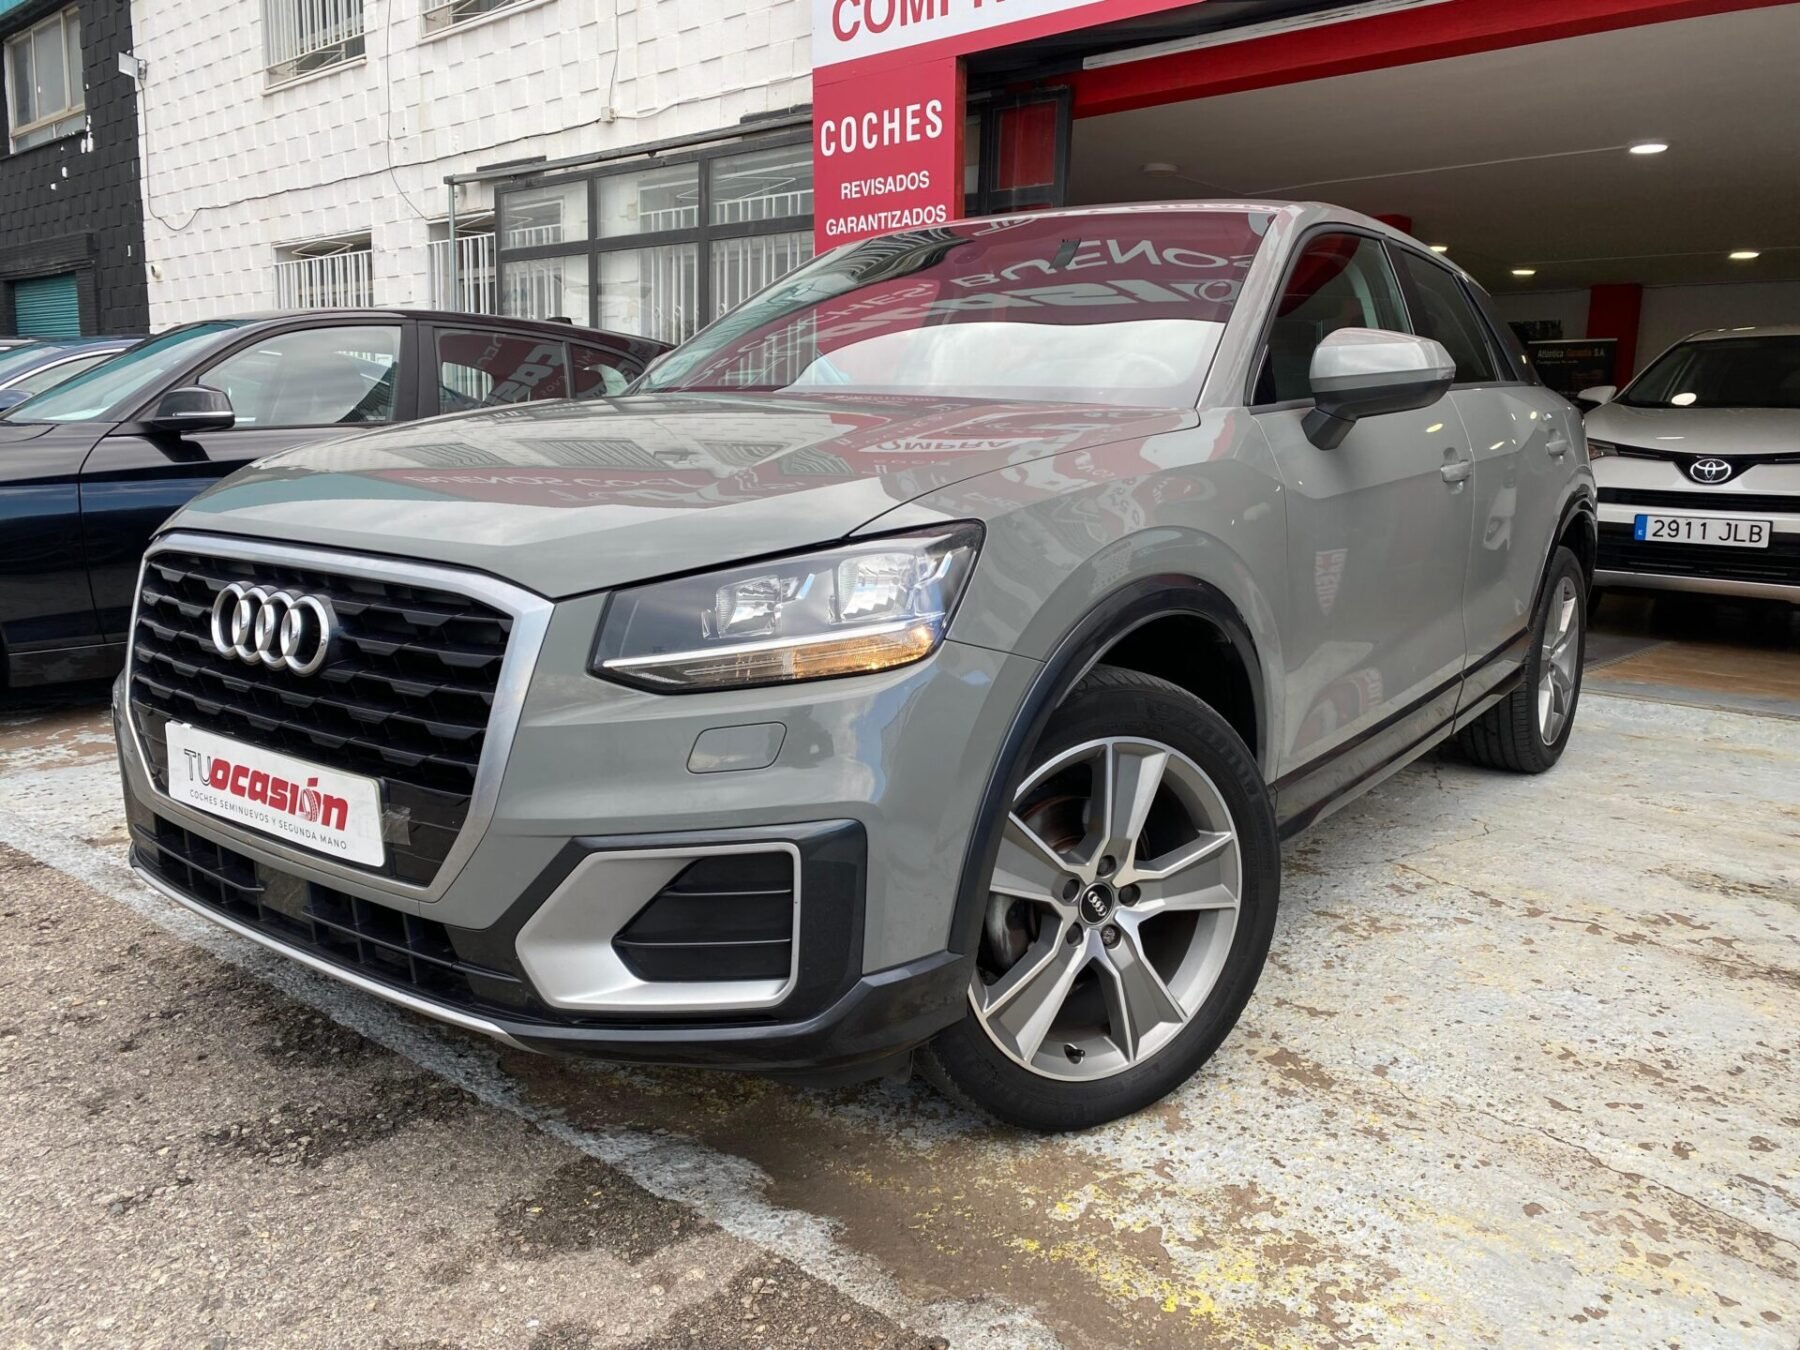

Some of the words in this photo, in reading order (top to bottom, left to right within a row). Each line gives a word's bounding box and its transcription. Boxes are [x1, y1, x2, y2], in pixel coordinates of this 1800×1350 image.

[820, 99, 943, 157] COCHES
[841, 170, 930, 200] REVISADOS
[825, 204, 947, 236] GARANTIZADOS
[1651, 519, 1707, 540] 2911
[1718, 523, 1763, 543] JLB
[189, 789, 218, 806] COCHES
[220, 796, 270, 824] SEMINUEVOS
[271, 816, 277, 826] Y
[279, 820, 317, 841] SEGUNDA
[319, 834, 348, 850] MANO
